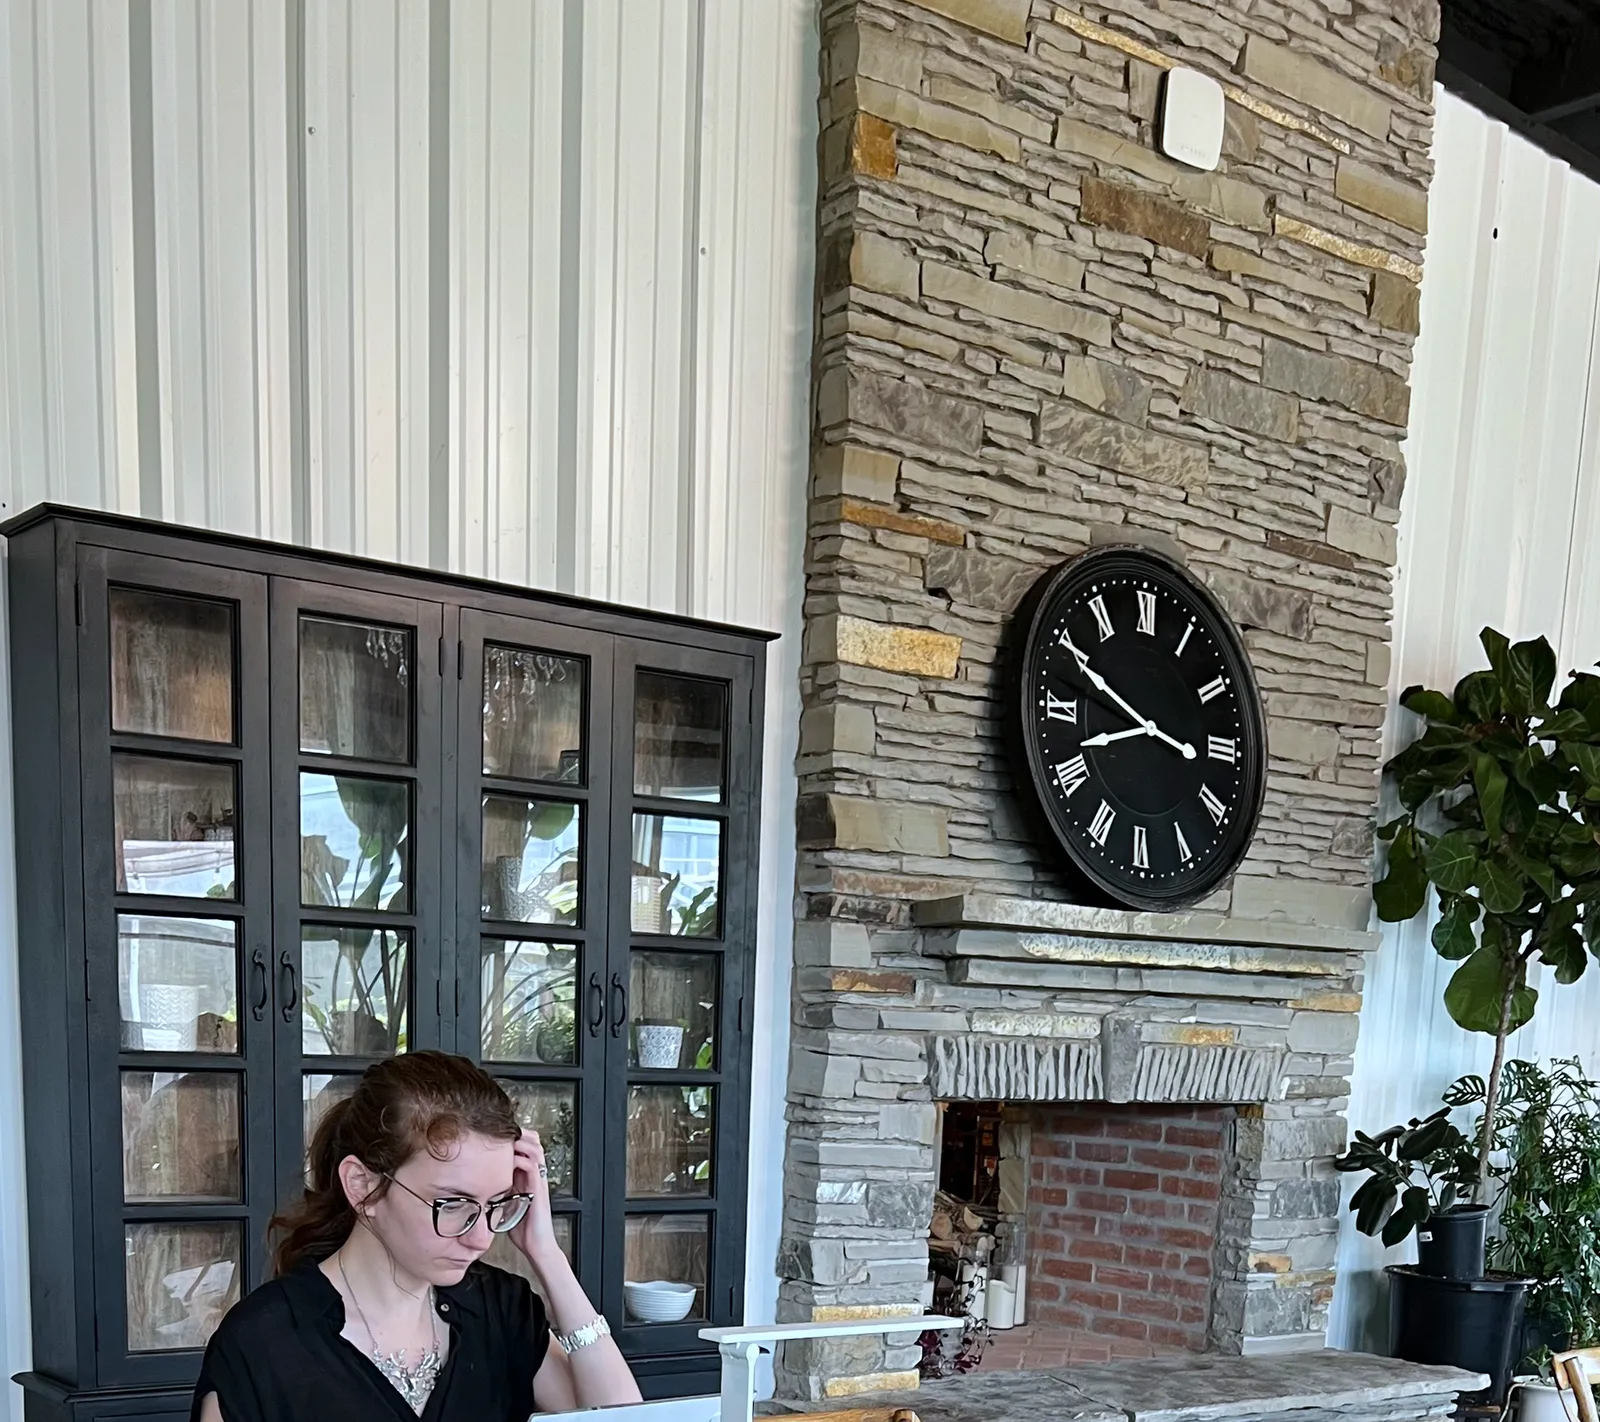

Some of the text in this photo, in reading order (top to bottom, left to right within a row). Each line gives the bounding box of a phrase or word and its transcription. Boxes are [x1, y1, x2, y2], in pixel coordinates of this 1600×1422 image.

[1087, 595, 1115, 642] XI
[1136, 590, 1156, 636] XII
[1058, 628, 1090, 672] X
[1174, 623, 1194, 657] I
[1047, 690, 1077, 724] IX
[1198, 675, 1226, 704] II
[1208, 734, 1235, 764] III
[1055, 753, 1090, 797] VIII
[1087, 799, 1116, 847] VII
[1199, 783, 1227, 826] IV
[1133, 825, 1150, 869] VI
[1174, 821, 1192, 863] V
